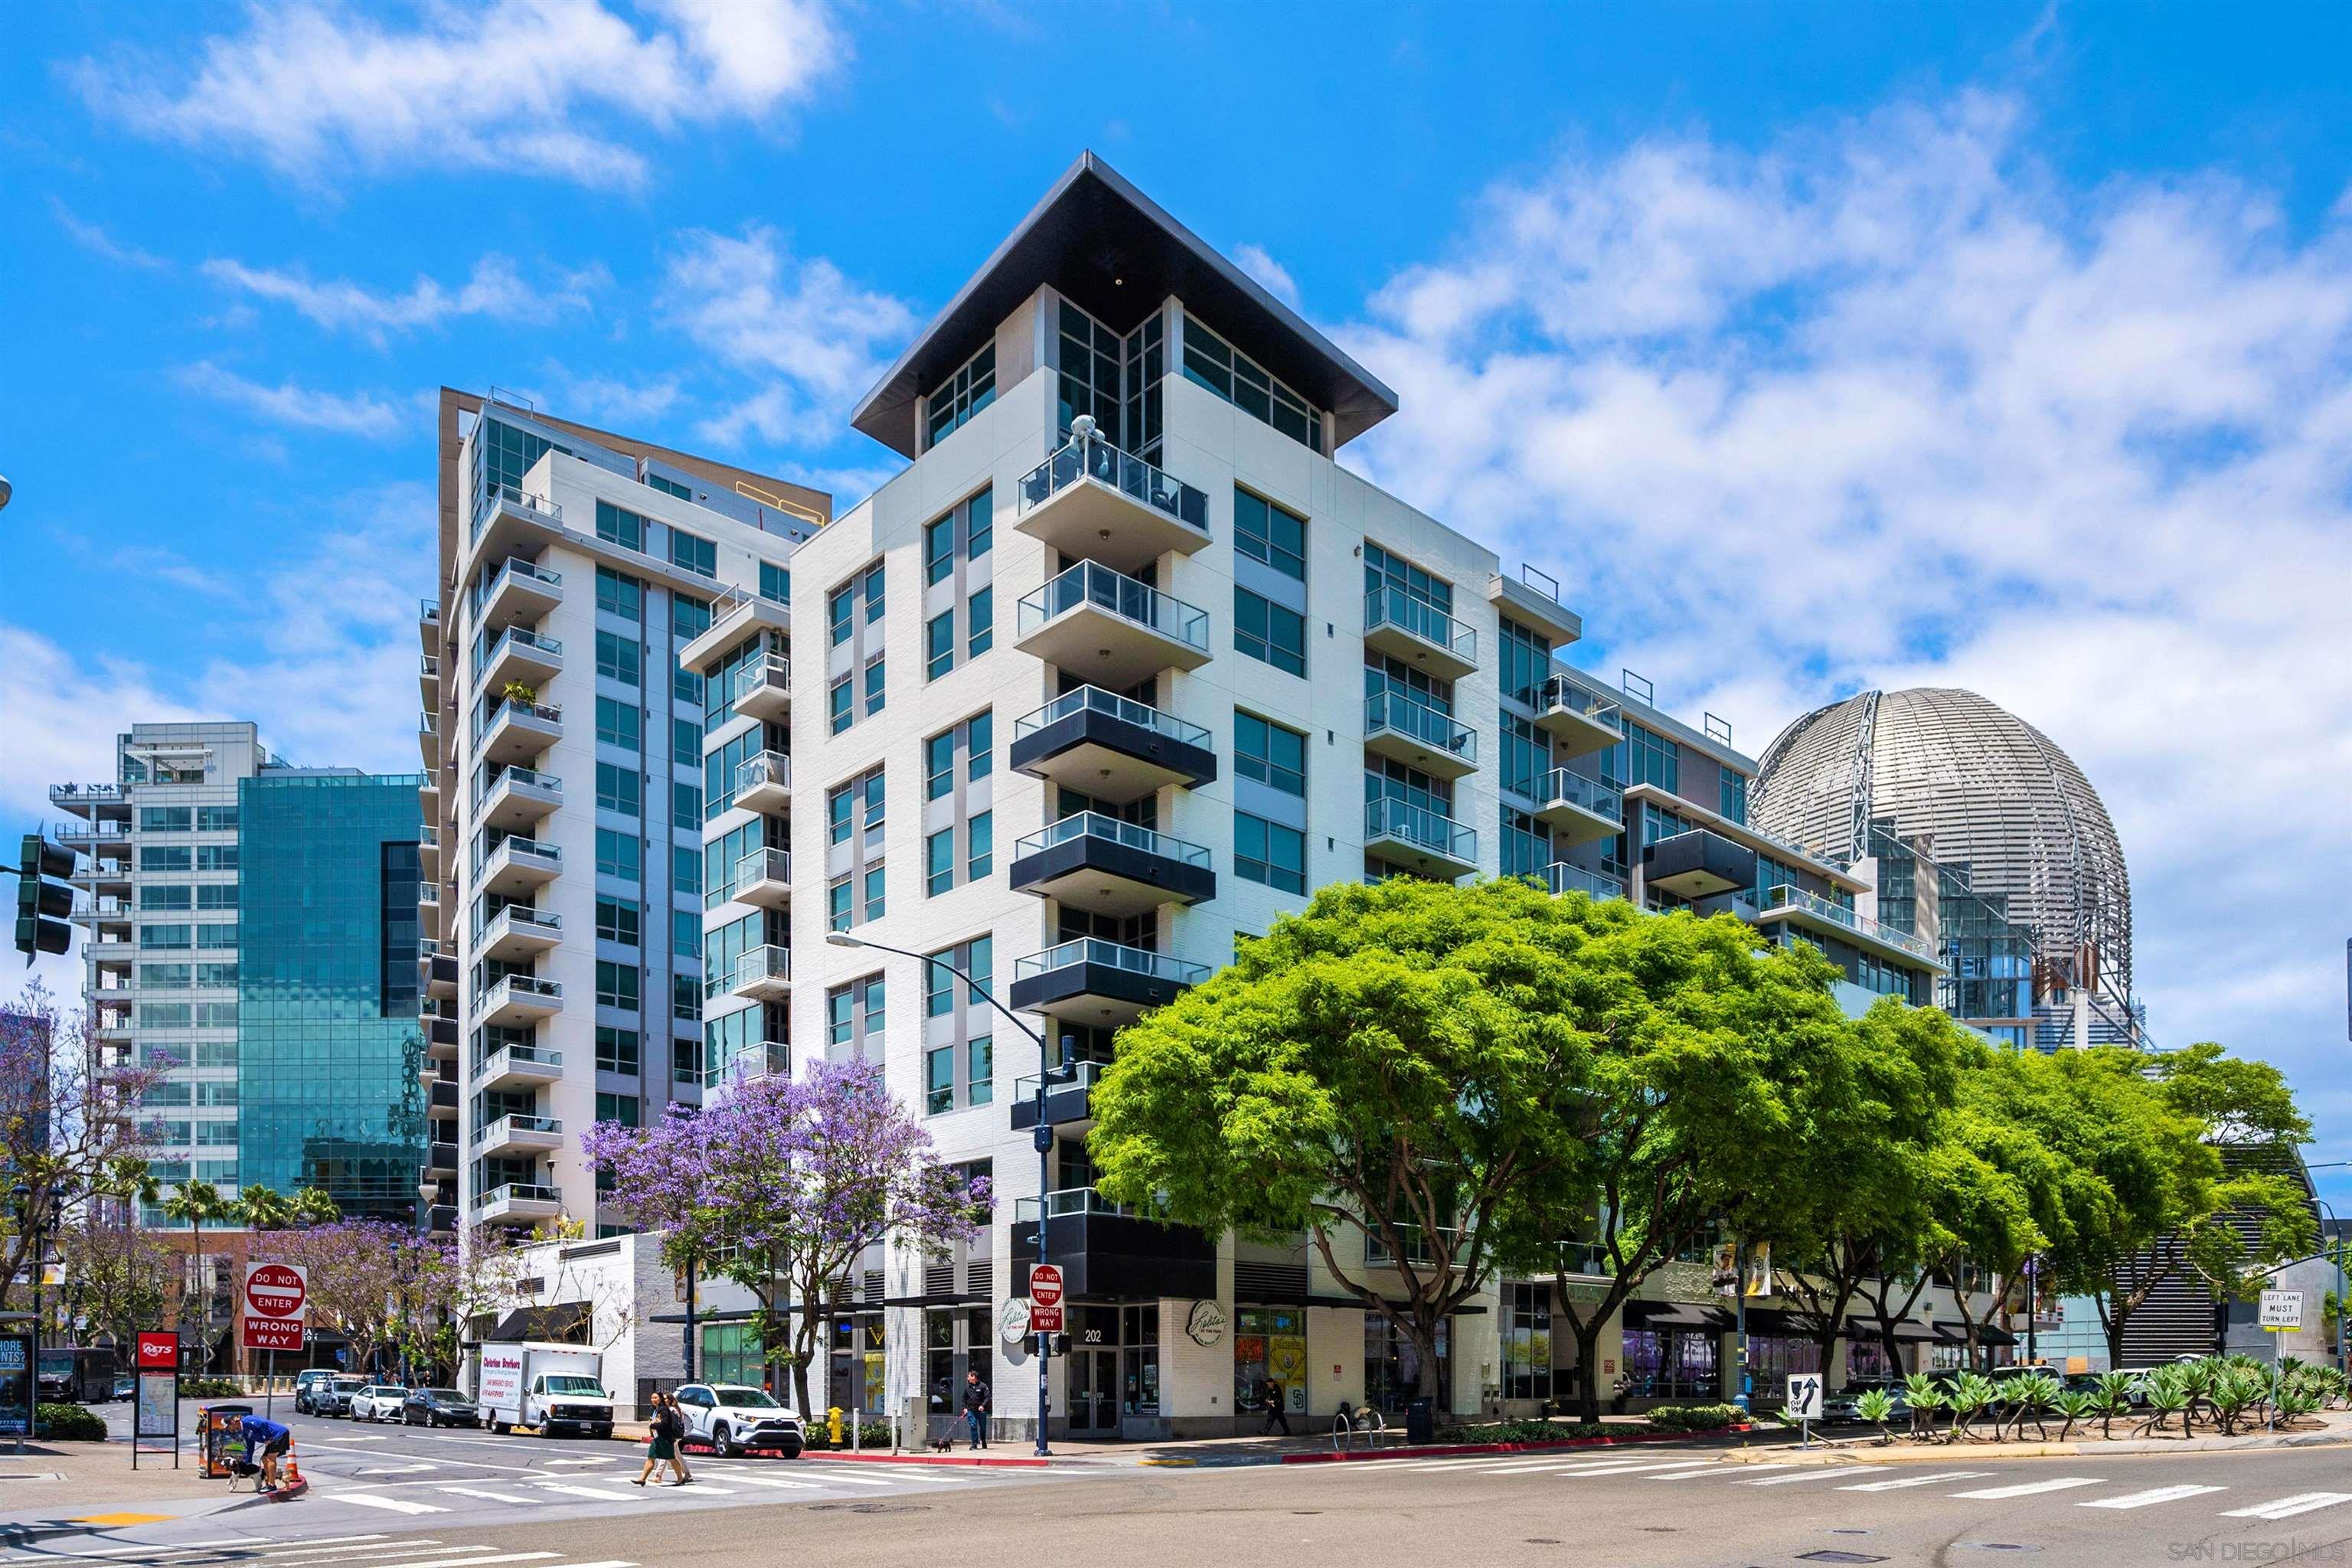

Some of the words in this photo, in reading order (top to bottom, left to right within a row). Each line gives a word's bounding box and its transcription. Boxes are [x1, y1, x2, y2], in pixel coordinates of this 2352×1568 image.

[256, 1273, 270, 1282] DO
[278, 1276, 298, 1285] NOT
[258, 1298, 292, 1308] ENTER
[1034, 1308, 1060, 1317] WRONG
[248, 1321, 299, 1332] WRONG
[1039, 1318, 1054, 1327] WAY
[257, 1334, 289, 1345] WAY
[1085, 1329, 1102, 1342] 202
[142, 1344, 173, 1355] MTS
